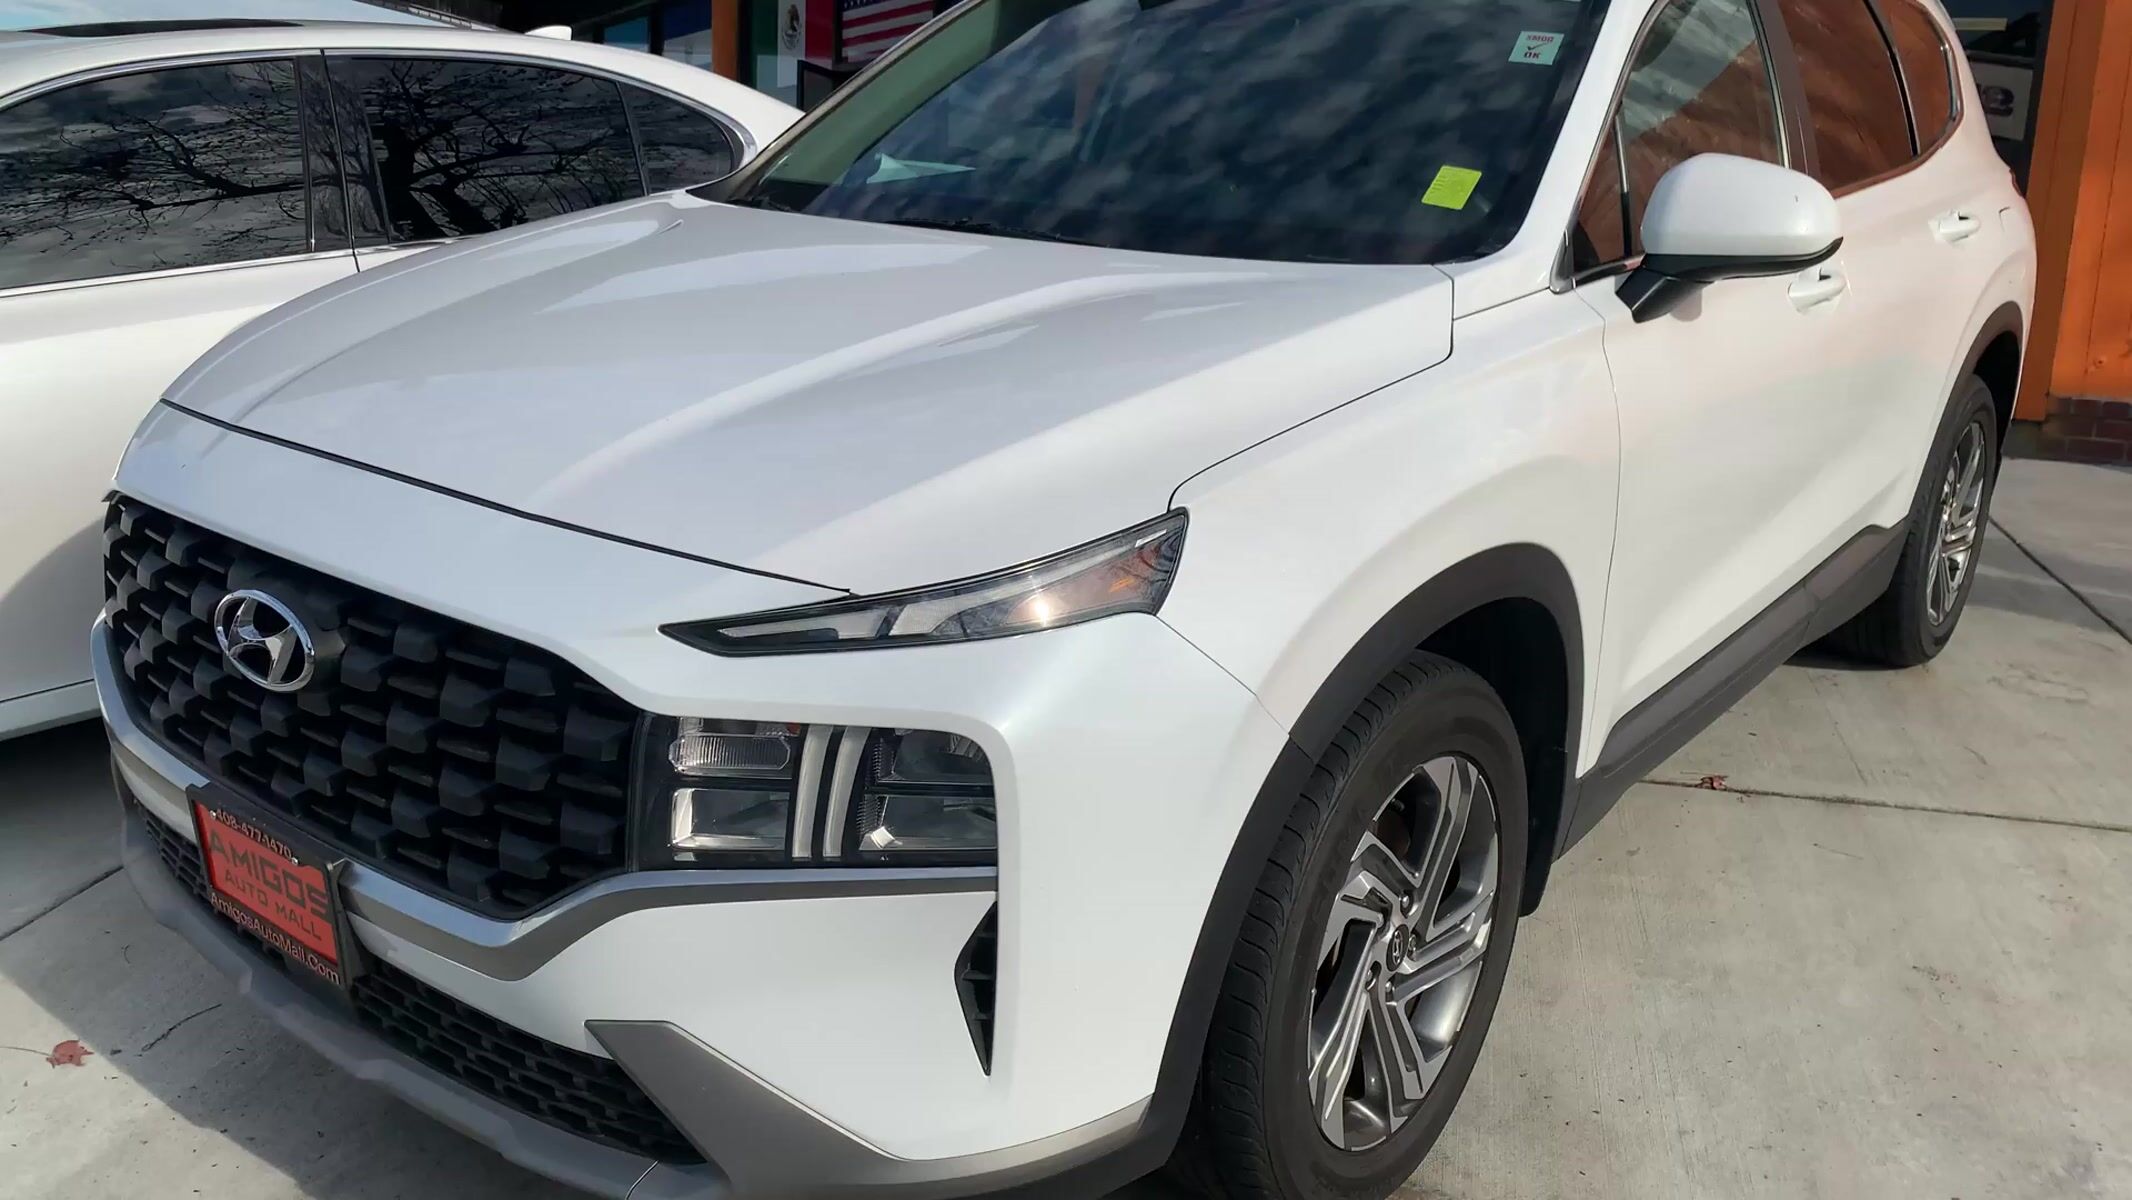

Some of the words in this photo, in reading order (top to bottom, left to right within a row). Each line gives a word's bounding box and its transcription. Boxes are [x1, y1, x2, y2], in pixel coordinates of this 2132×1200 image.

[1524, 51, 1541, 59] OK
[215, 808, 292, 860] 408-477-1470
[208, 828, 329, 918] AMIGOS
[225, 870, 269, 906] AUTO
[275, 902, 323, 941] MALL
